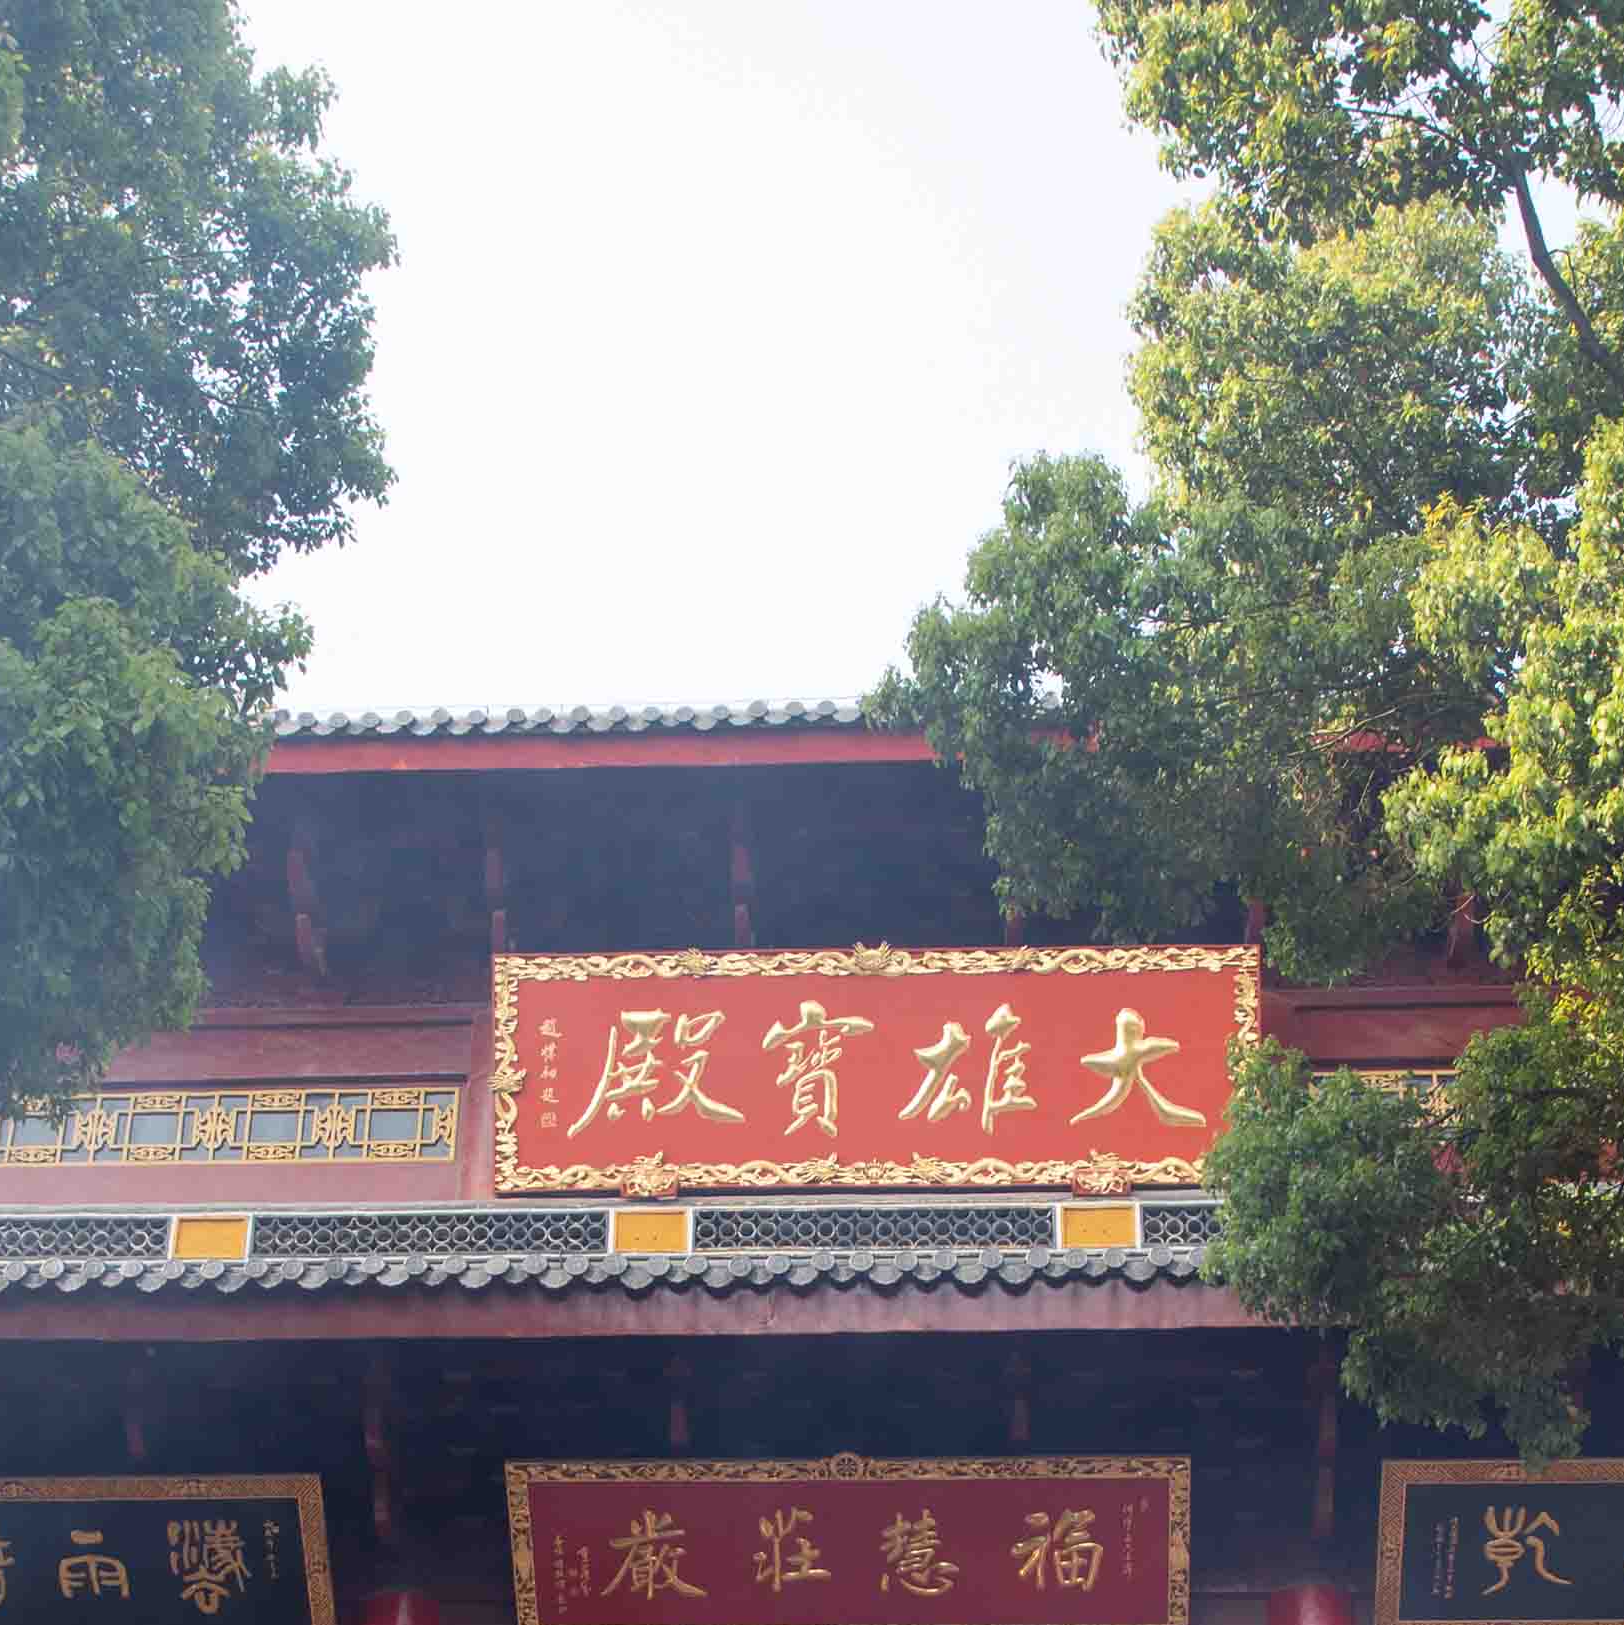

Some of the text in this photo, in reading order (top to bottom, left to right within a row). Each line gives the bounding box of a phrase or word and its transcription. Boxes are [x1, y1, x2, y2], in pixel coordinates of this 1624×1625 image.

[567, 999, 1208, 1138] 大雄寶殿
[601, 1507, 1104, 1600] 福慧莊嚴
